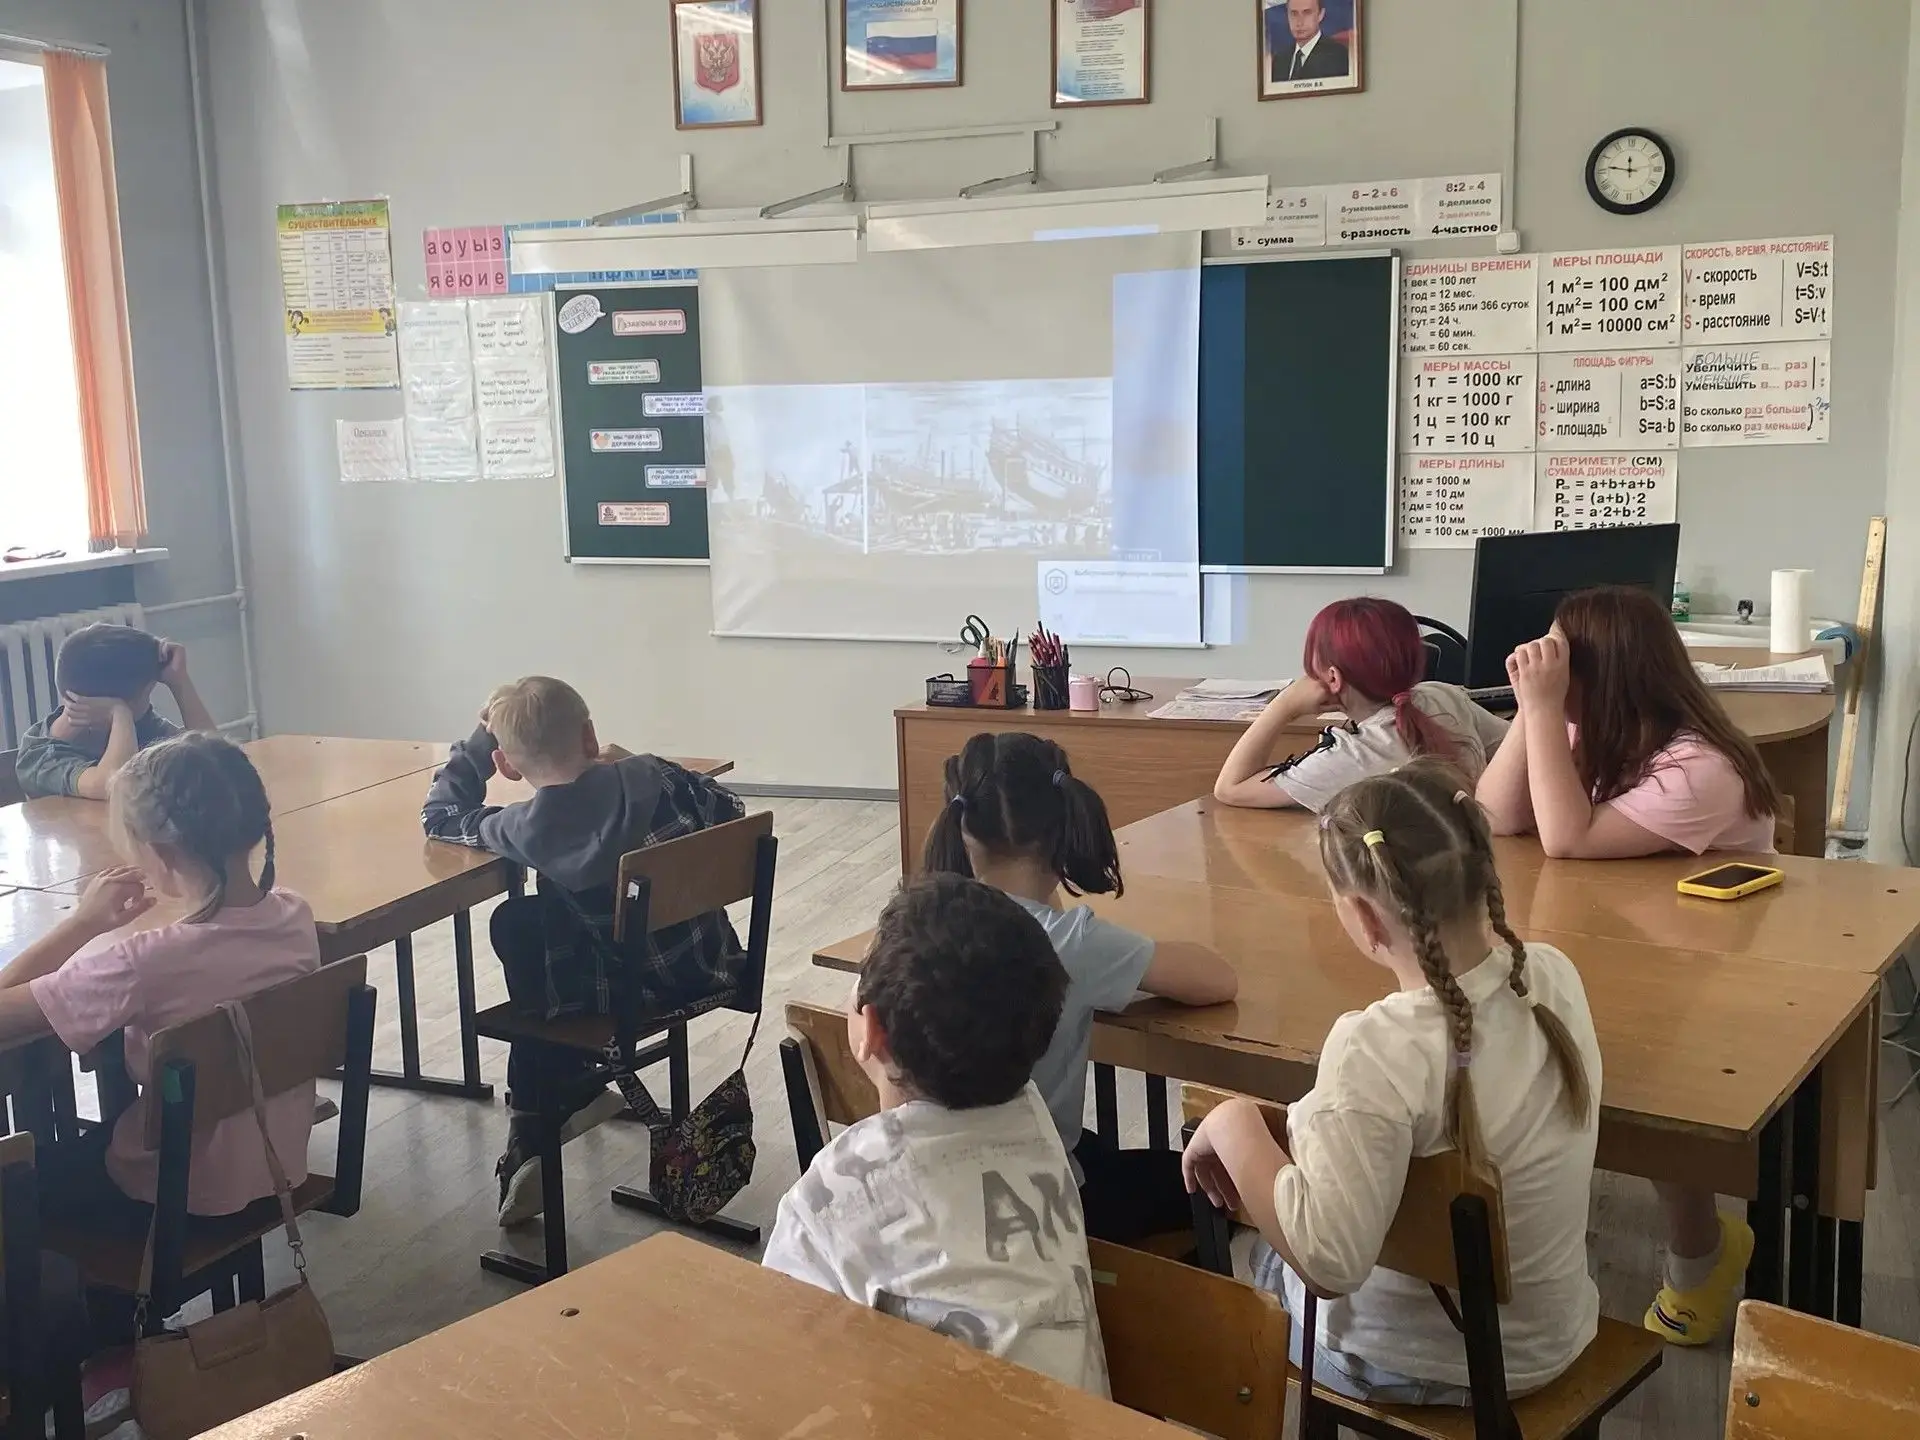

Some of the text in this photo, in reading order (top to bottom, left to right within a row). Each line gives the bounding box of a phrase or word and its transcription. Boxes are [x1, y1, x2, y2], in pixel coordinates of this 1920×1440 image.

[1477, 181, 1485, 190] 4
[1352, 187, 1398, 200] 8 2 6
[1276, 198, 1307, 208] 2 5
[1340, 228, 1411, 240] 6-разность
[1431, 224, 1498, 235] 4-частное
[1238, 236, 1294, 247] 5 сумма
[1770, 241, 1829, 254] РАССТОЯНИЕ
[1553, 252, 1663, 267] МЕРЫ ПЛОЩАДИ
[1406, 260, 1531, 276] ЕДИНИЦЫ ВРЕМЕНИ
[1440, 276, 1456, 285] 100
[1459, 277, 1476, 285] лет
[1684, 269, 1757, 286] V скорость
[1547, 280, 1554, 294] 1
[1600, 276, 1629, 291] 100
[1439, 290, 1450, 298] 12
[1410, 306, 1428, 314] год
[1438, 302, 1456, 312] 365
[1480, 300, 1498, 310] 366
[1500, 301, 1530, 312] суток
[1600, 297, 1628, 312] 100
[1700, 293, 1736, 310] время
[1438, 316, 1450, 325] 24
[1546, 321, 1553, 335] 1
[1598, 318, 1642, 333] 10000
[1684, 314, 1770, 332] S расстояние
[1438, 328, 1450, 338] 60
[1452, 330, 1475, 338] мин.
[1438, 342, 1450, 351] 60
[1424, 360, 1511, 372] МЕРЫ МАССЫ
[1573, 356, 1654, 368] ПЛОЩАДЬ ФИГУРЫ
[1686, 362, 1758, 373] Увеличить
[1785, 361, 1808, 372] раз
[1414, 372, 1523, 388] 1 т 1000 кг
[1686, 381, 1756, 391] Уменьшить
[1784, 380, 1808, 390] раз
[1556, 380, 1590, 394] длина
[1414, 392, 1513, 408] 1 кг 1000 г
[1556, 401, 1600, 416] ширина
[1684, 406, 1698, 416] Во
[1700, 406, 1742, 416] сколько
[1744, 407, 1763, 418] раз
[1765, 404, 1807, 414] больше
[1414, 412, 1511, 429] 1 ц 100 кг
[1540, 420, 1607, 438] S площадь
[1684, 422, 1807, 433] Во сколько раз меньше
[1412, 432, 1495, 448] 1 т 10 ц
[1419, 459, 1504, 470] МЕРЫ ДЛИНЫ
[1550, 456, 1662, 467] ПЕРИМЕТР (СМ)
[1545, 466, 1665, 478] (СУММА ДЛИН СТОРОН)
[1436, 476, 1460, 486] 1000
[1590, 478, 1656, 490] a+b+a+b
[1436, 488, 1447, 498] 10
[1436, 502, 1446, 510] 10
[1435, 515, 1465, 524] 10 мм
[1410, 528, 1417, 536] м
[1435, 526, 1452, 536] 100
[1482, 527, 1506, 536] 1000
